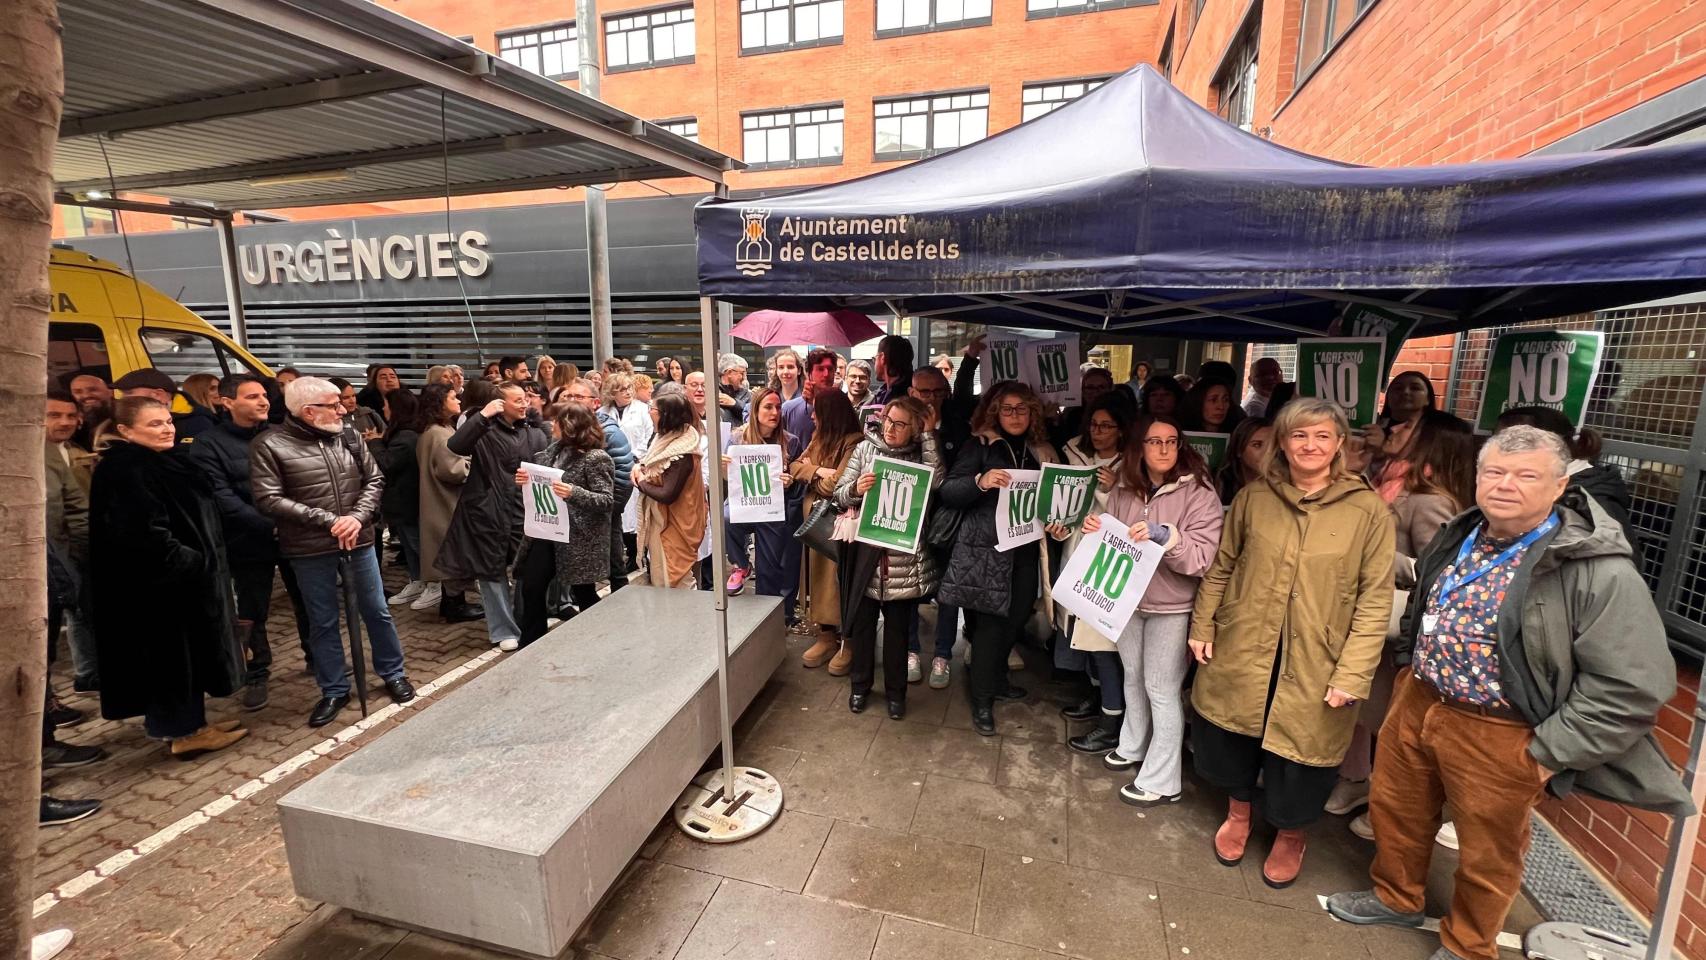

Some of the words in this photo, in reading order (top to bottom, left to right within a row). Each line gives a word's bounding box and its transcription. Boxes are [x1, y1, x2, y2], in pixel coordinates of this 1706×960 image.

[780, 215, 907, 240] Ajuntament
[239, 228, 489, 285] URGÈNCIES
[779, 242, 804, 262] de
[811, 239, 960, 262] Castelldefels
[1313, 349, 1364, 364] L'AGRESSIÓ
[1513, 338, 1578, 354] L'AGRESSIÓ
[991, 347, 1019, 380] NO
[1037, 351, 1069, 390] NO
[1508, 351, 1569, 408] NO
[1314, 361, 1359, 409] NO
[739, 454, 771, 464] L'AGRESSIÓ
[740, 462, 772, 498] NO
[882, 468, 919, 486] L'AGRESSIÓ
[532, 482, 558, 516] NO
[749, 496, 772, 506] SOLUCIÓ
[876, 479, 914, 522] NO
[1009, 488, 1038, 528] NO
[1050, 483, 1088, 520] NO
[880, 517, 908, 533] SOLUCIÓ
[1102, 530, 1143, 563] L'AGRESSIÓ
[1082, 541, 1134, 600] NO
[1082, 585, 1116, 614] SOLUCIÓ
